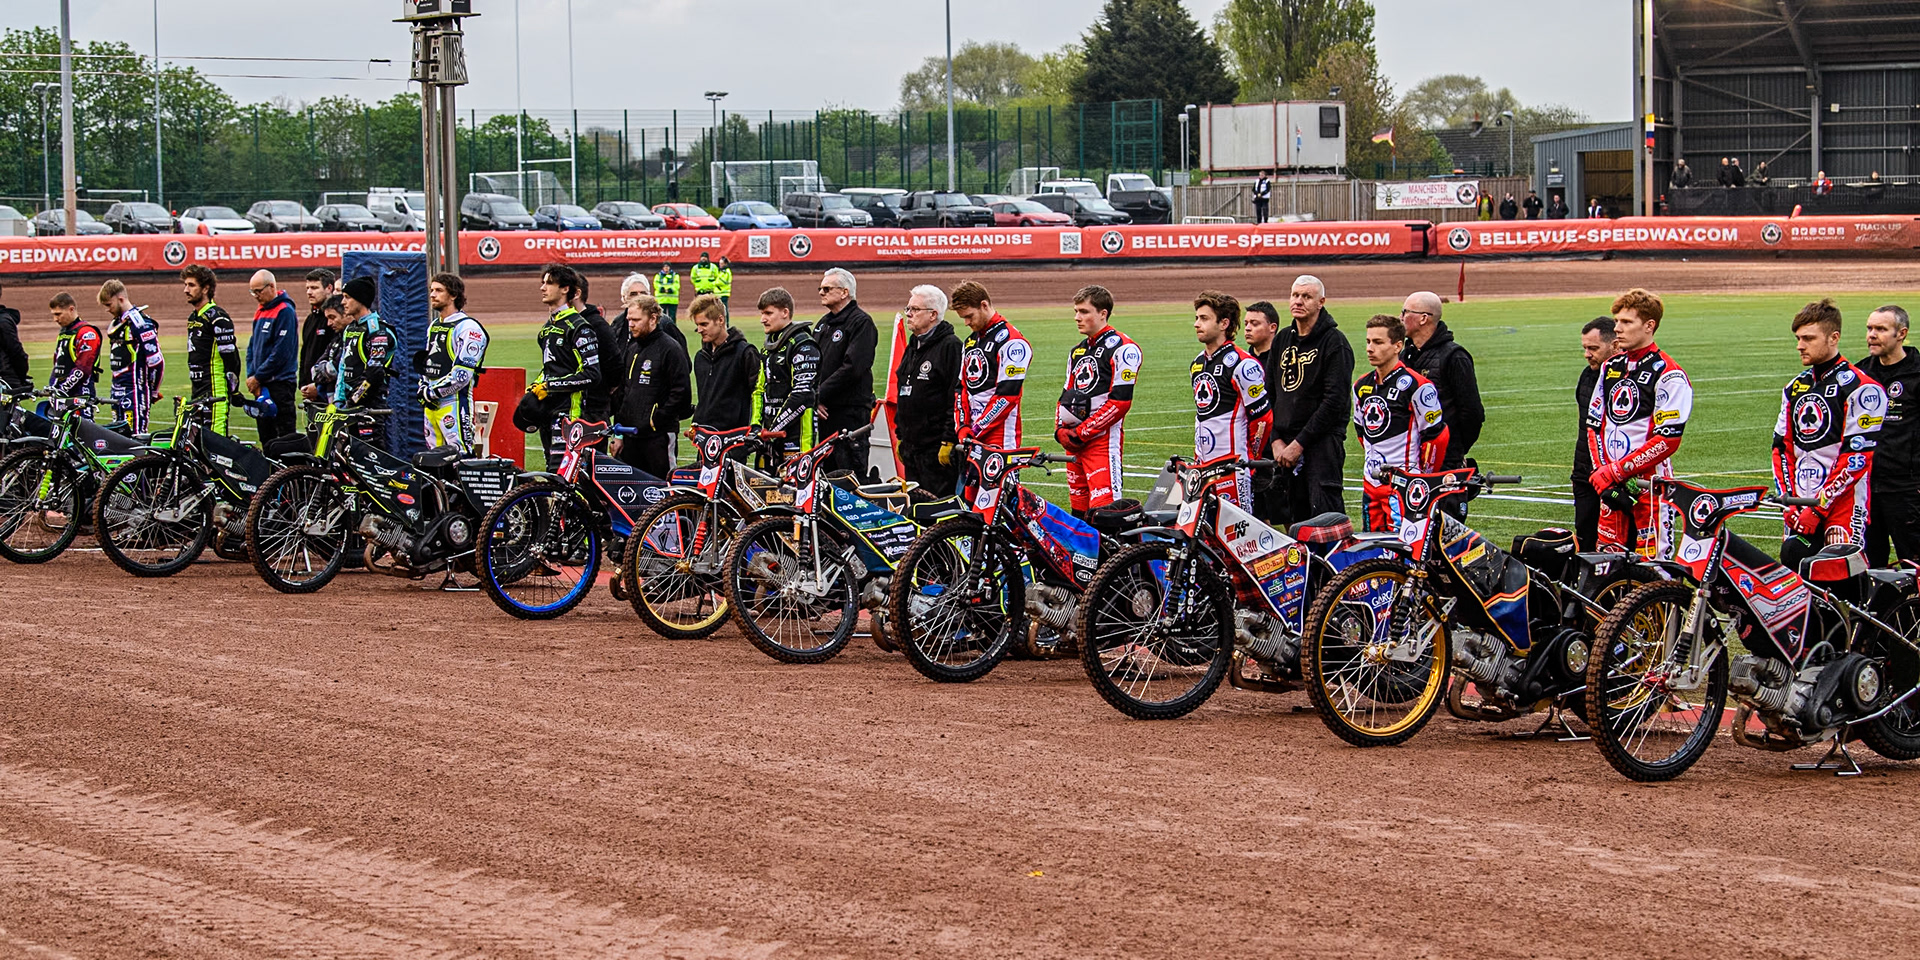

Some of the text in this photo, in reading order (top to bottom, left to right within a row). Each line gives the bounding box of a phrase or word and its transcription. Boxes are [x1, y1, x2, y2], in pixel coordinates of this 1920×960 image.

[1408, 184, 1448, 194] MANCHESTER
[524, 237, 721, 250] OFFICIAL MERCHANDISE
[835, 234, 1033, 247] OFFICIAL MERCHANDISE
[1132, 232, 1391, 249] BELLEVUE-SPEEDWAY.COM
[1479, 228, 1738, 246] BELLEVUE-SPEEDWAY.COM
[565, 250, 681, 258] BELLEVUE-SPEEDWAY.COM/SHOP
[1594, 562, 1610, 576] 57
[1350, 581, 1368, 595] AMD
